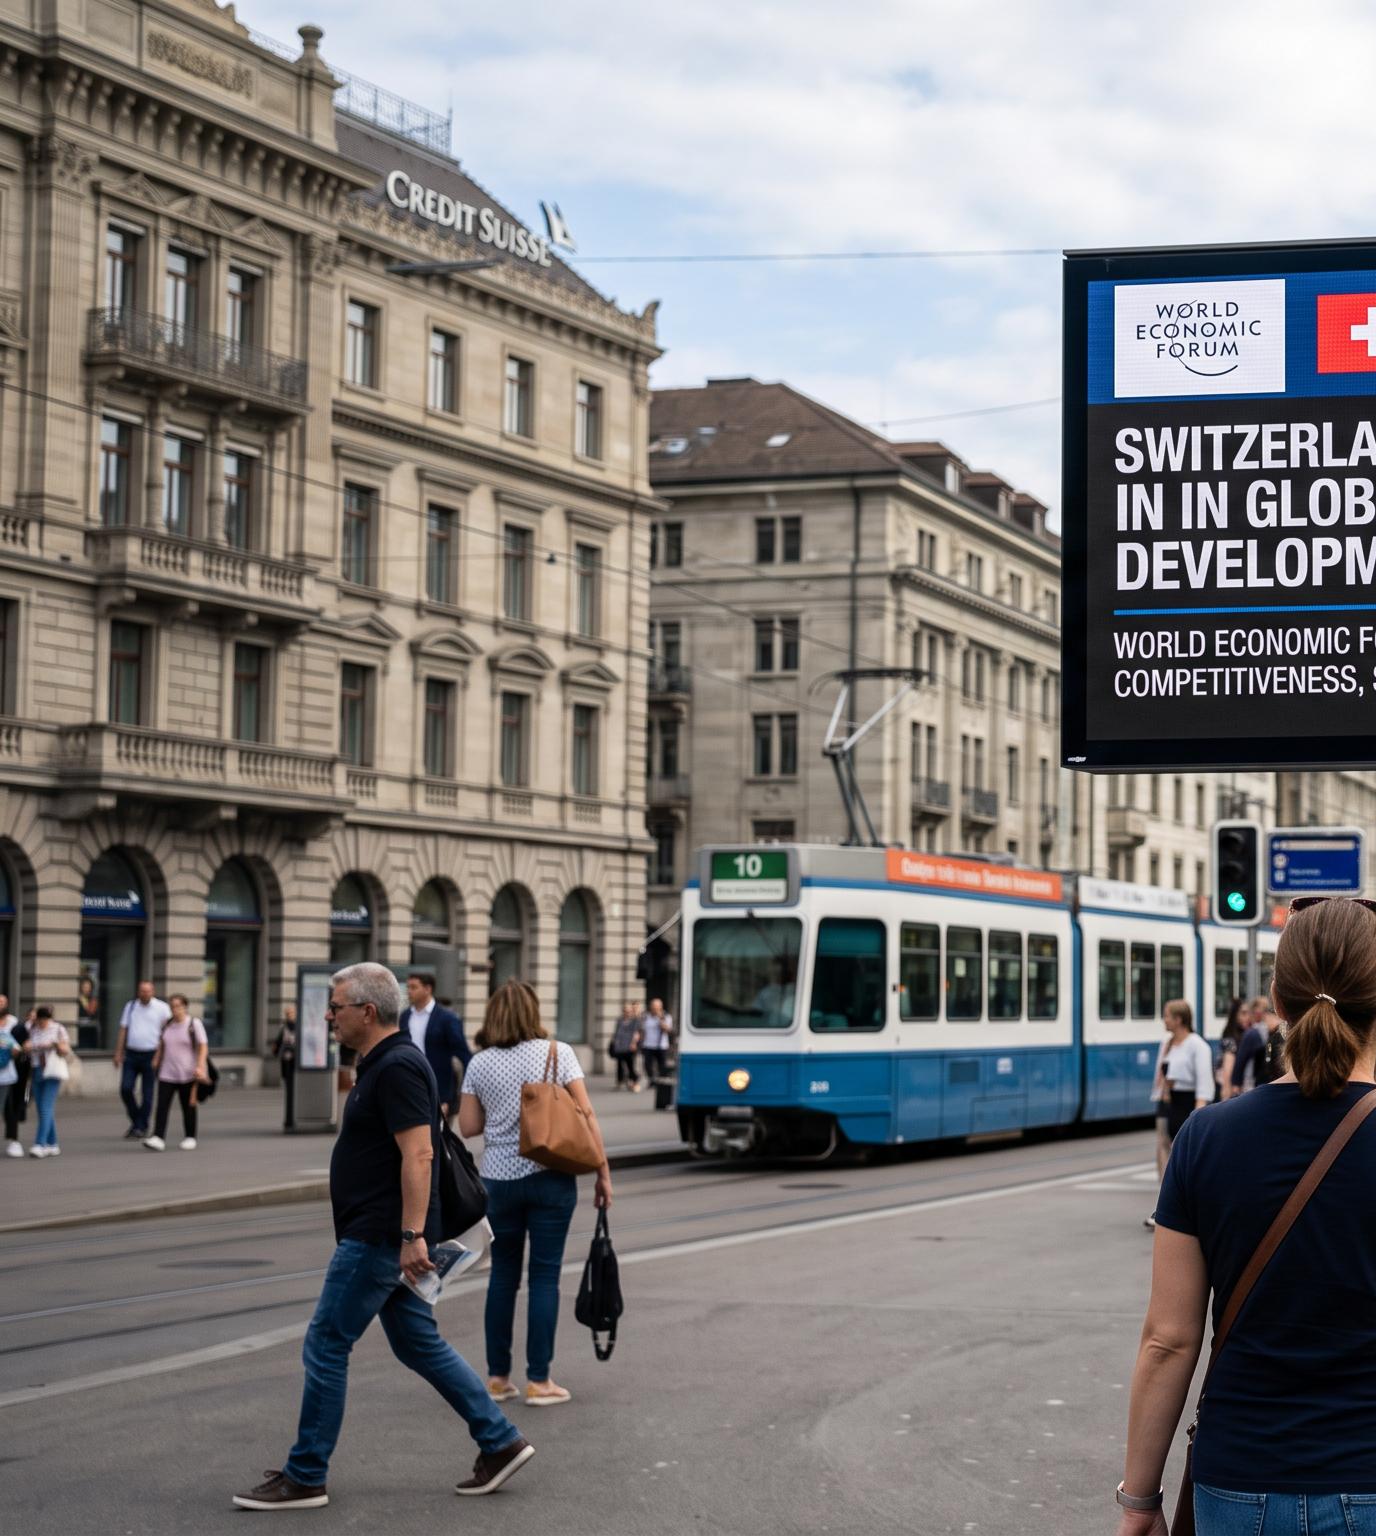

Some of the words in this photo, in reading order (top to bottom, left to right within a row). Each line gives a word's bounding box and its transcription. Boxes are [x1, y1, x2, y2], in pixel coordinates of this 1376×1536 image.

[1156, 301, 1239, 319] WORLD
[1136, 320, 1261, 340] ECONOMIC
[1156, 341, 1239, 358] FORUM
[1116, 483, 1164, 532] IN
[1181, 481, 1228, 530] IN
[1113, 630, 1206, 659] WORLD
[1214, 627, 1351, 657] ECONOMIC
[1114, 665, 1364, 698] COMPETITIVENESS,
[733, 854, 763, 877] 10
